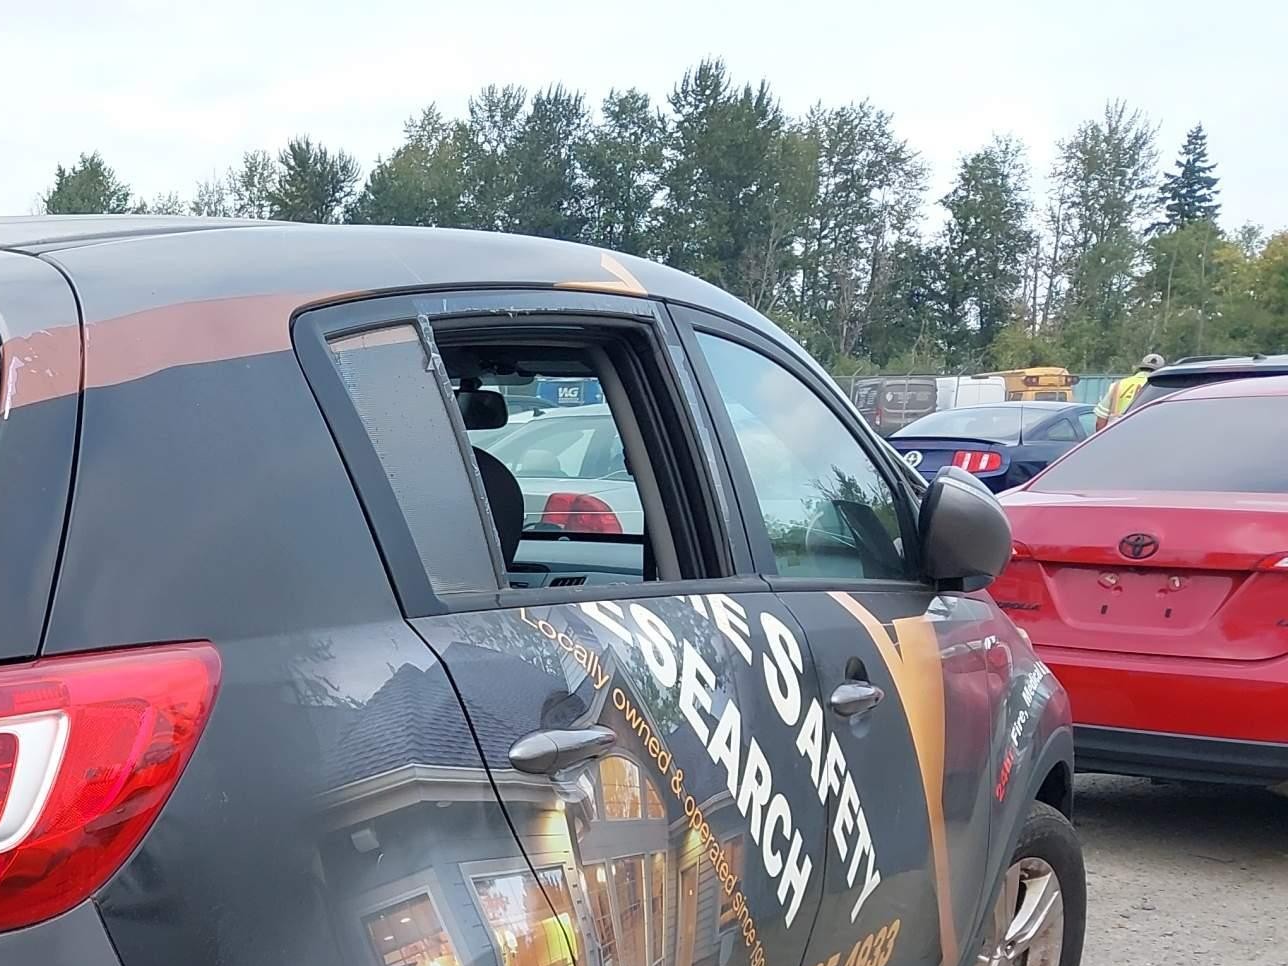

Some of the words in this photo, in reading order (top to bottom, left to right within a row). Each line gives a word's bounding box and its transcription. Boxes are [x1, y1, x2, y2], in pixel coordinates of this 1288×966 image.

[520, 607, 610, 689] Locally
[612, 687, 673, 775] owned
[670, 768, 685, 800] &
[684, 794, 739, 897] operated
[731, 890, 756, 948] since
[569, 600, 813, 929] ESEARCH
[759, 611, 879, 923] SAFETY
